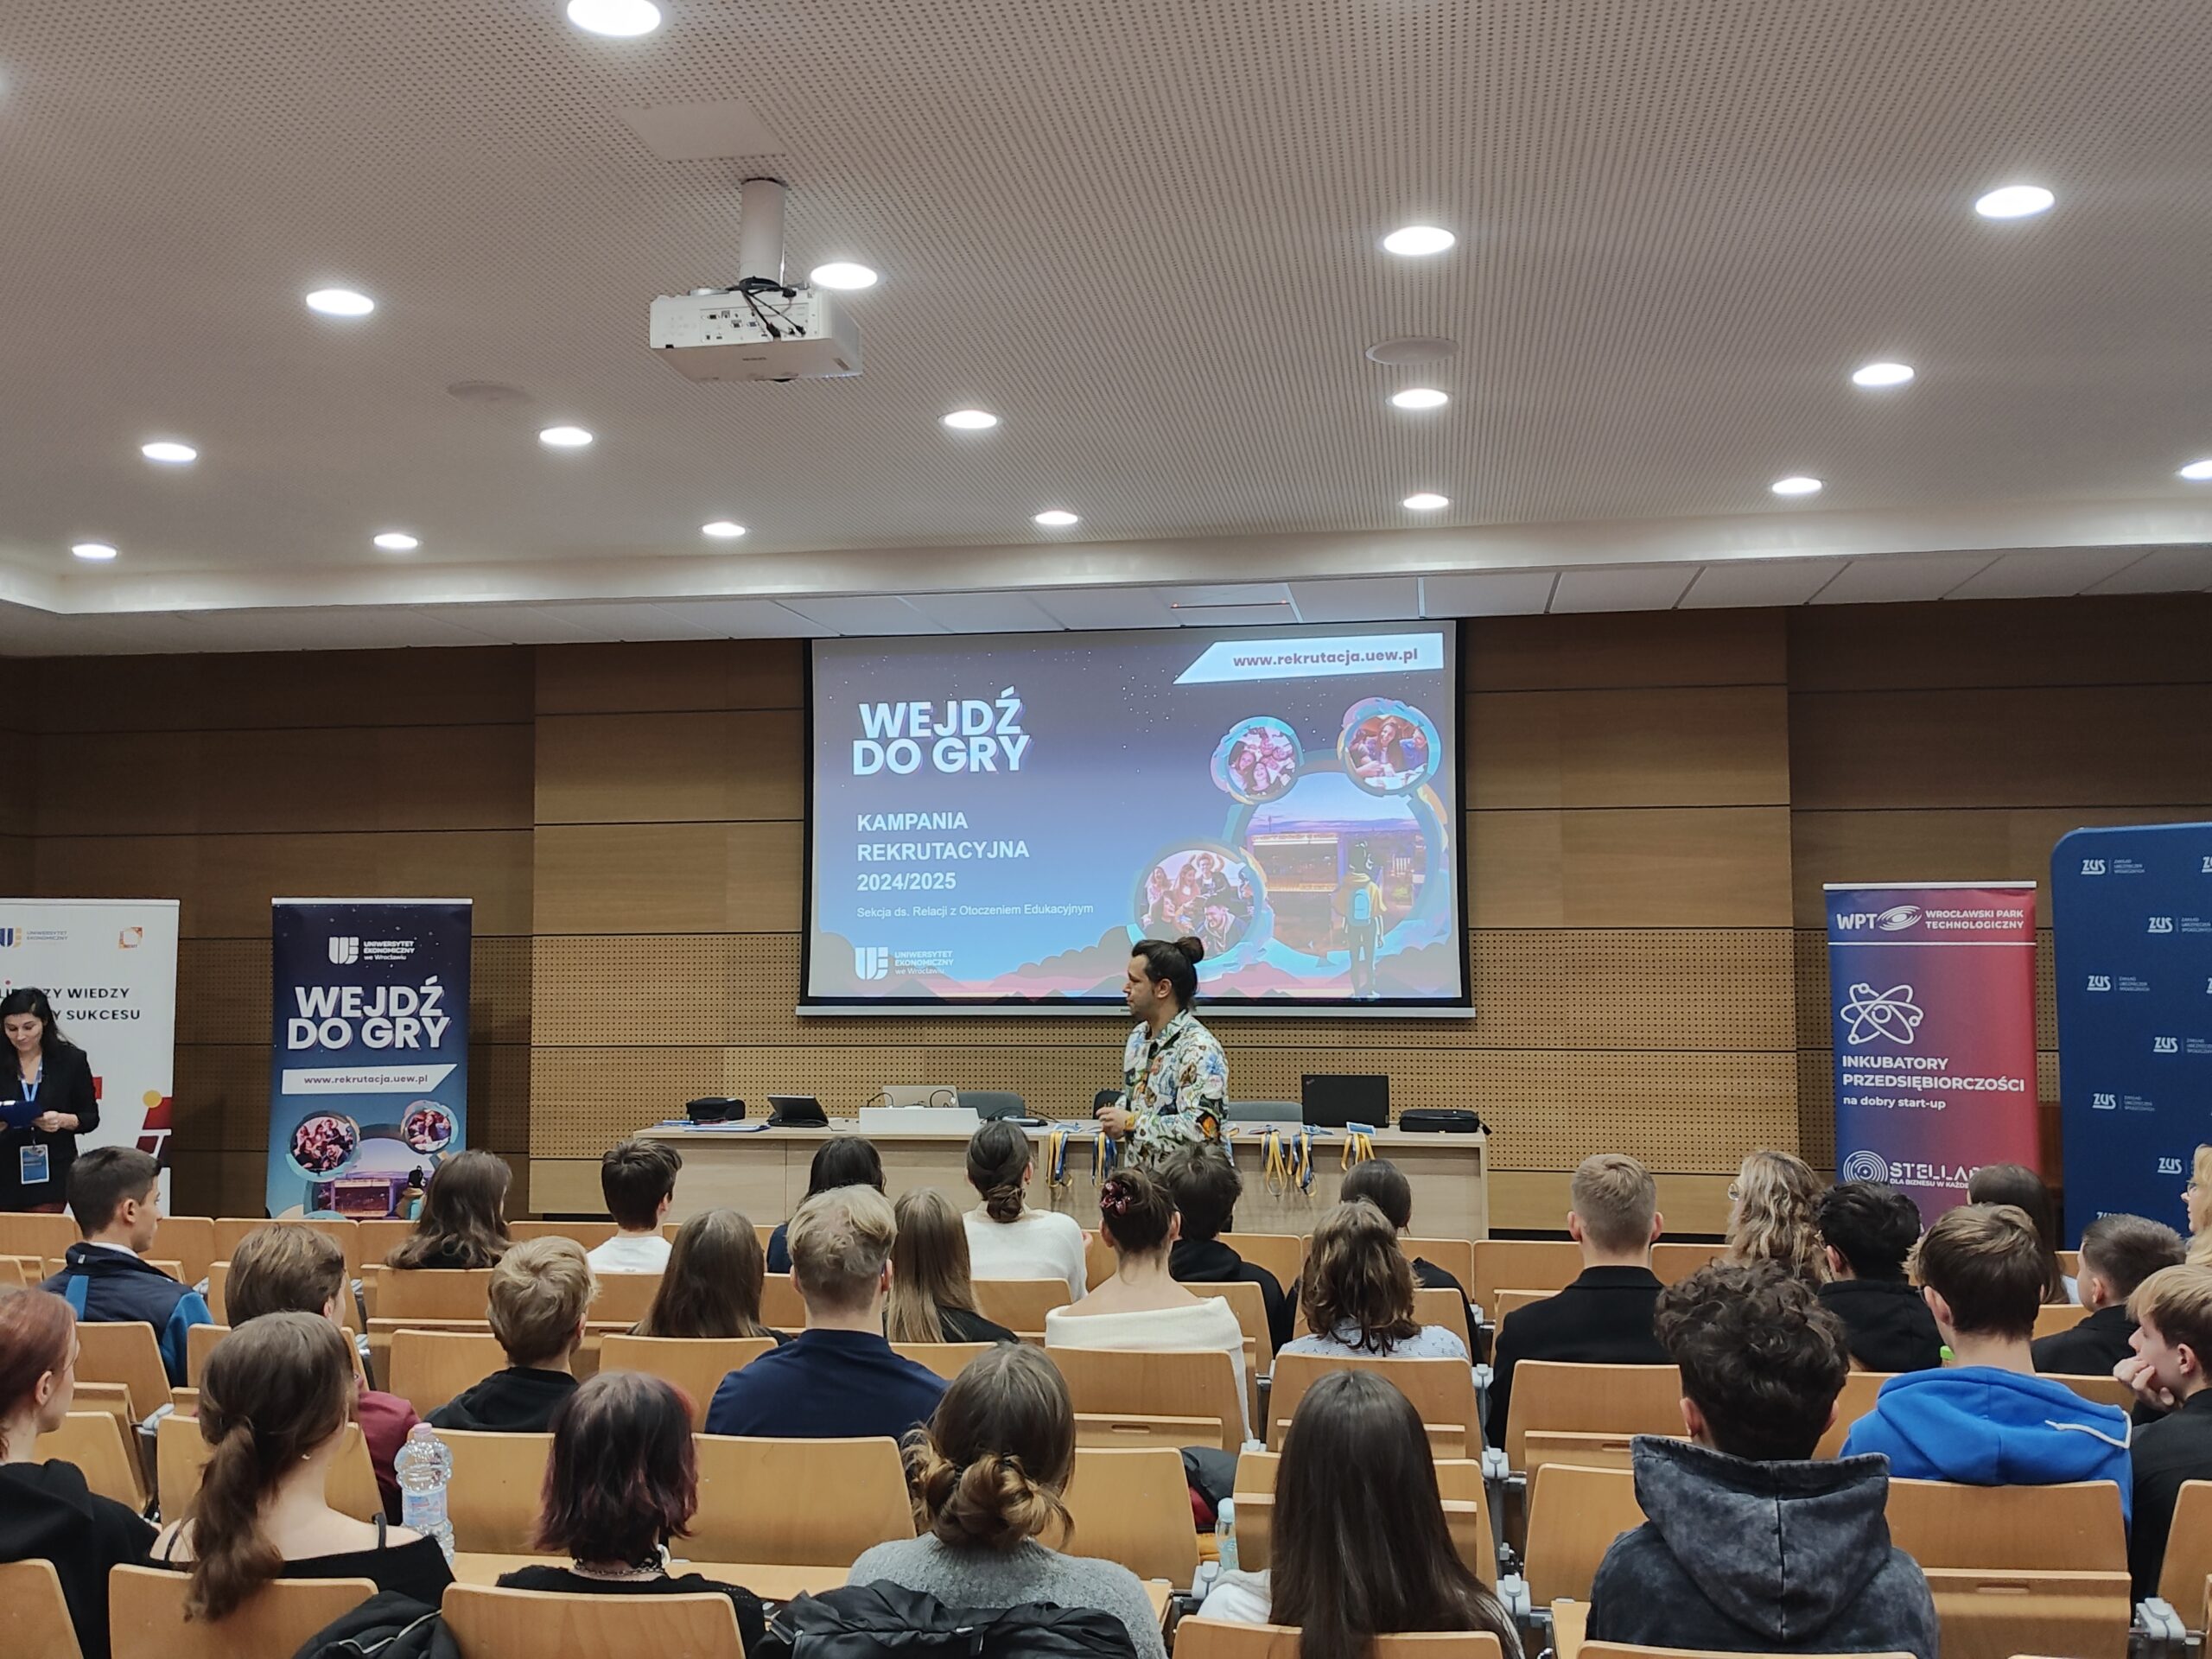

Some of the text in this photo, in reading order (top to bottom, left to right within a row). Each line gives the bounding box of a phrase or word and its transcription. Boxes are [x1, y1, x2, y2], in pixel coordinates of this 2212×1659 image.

[1233, 648, 1419, 667] www.rekrutacja.uew.pl
[857, 685, 1023, 739] WEJDŹ
[852, 734, 1033, 776] DO GRY
[856, 811, 969, 832] KAMPANIA
[856, 840, 1030, 862] REKRUTACYJNA
[2080, 859, 2107, 875] ZUS
[856, 872, 957, 892] 2024/2025
[856, 907, 892, 919] Sekcja
[893, 906, 910, 917] ds.
[912, 905, 948, 918] Relacji
[959, 905, 1021, 917] Otoczeniem
[1024, 903, 1094, 917] Edukacyjnym
[1925, 910, 2024, 919] WROCŁAWSKI PARK
[1836, 913, 1878, 931] WPT
[1925, 920, 2024, 930] TECHNOLOGICZNY
[2147, 917, 2173, 933] ZUS
[894, 958, 955, 967] EKONOMICZNY
[2087, 975, 2112, 992] ZUS
[67, 988, 130, 999] WIEDZY
[295, 976, 445, 1019] WEJDŹ
[67, 1009, 141, 1020] SUKCESU
[288, 1016, 452, 1051] DO GRY
[2153, 1037, 2178, 1053] ZUS
[1842, 1055, 1949, 1071] INKUBATORY
[304, 1074, 429, 1086] www.rekrutacja.uew.pl
[1842, 1073, 2025, 1092] PRZEDSIĘBIORCZOŚCI
[1843, 1096, 1947, 1111] na dobry start-up
[2092, 1093, 2117, 1110] ZUS
[2158, 1158, 2183, 1175] ZUS
